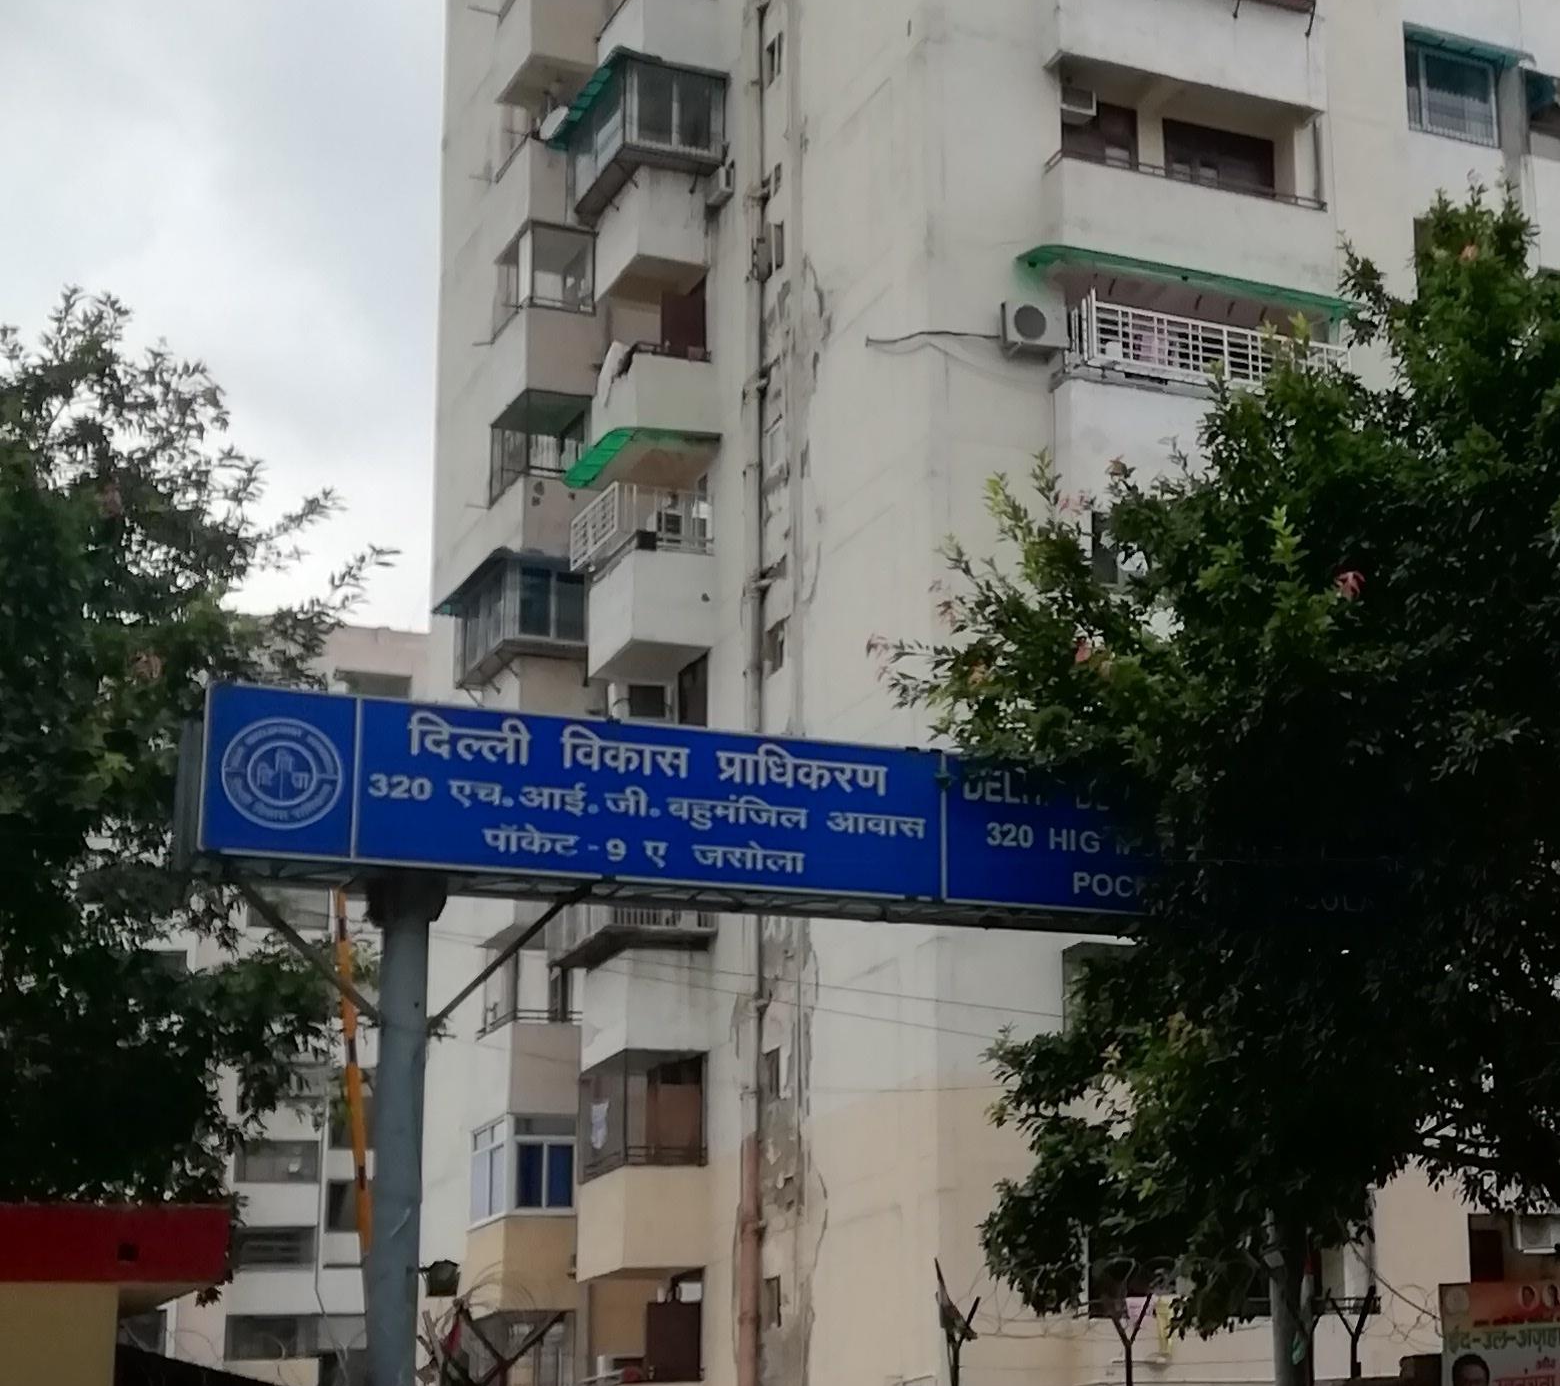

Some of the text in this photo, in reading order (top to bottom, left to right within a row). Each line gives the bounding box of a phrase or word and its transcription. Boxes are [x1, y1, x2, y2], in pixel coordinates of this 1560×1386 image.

[408, 712, 888, 797] दिल्ली विकास प्राधिकरण
[368, 773, 433, 801] 320
[826, 810, 926, 839] आवास
[962, 769, 1049, 807] DEL
[985, 821, 1035, 849] 320
[1048, 827, 1102, 854] HIG
[643, 840, 669, 868] ए
[691, 841, 805, 874] जसोला
[1072, 871, 1144, 897] POC
